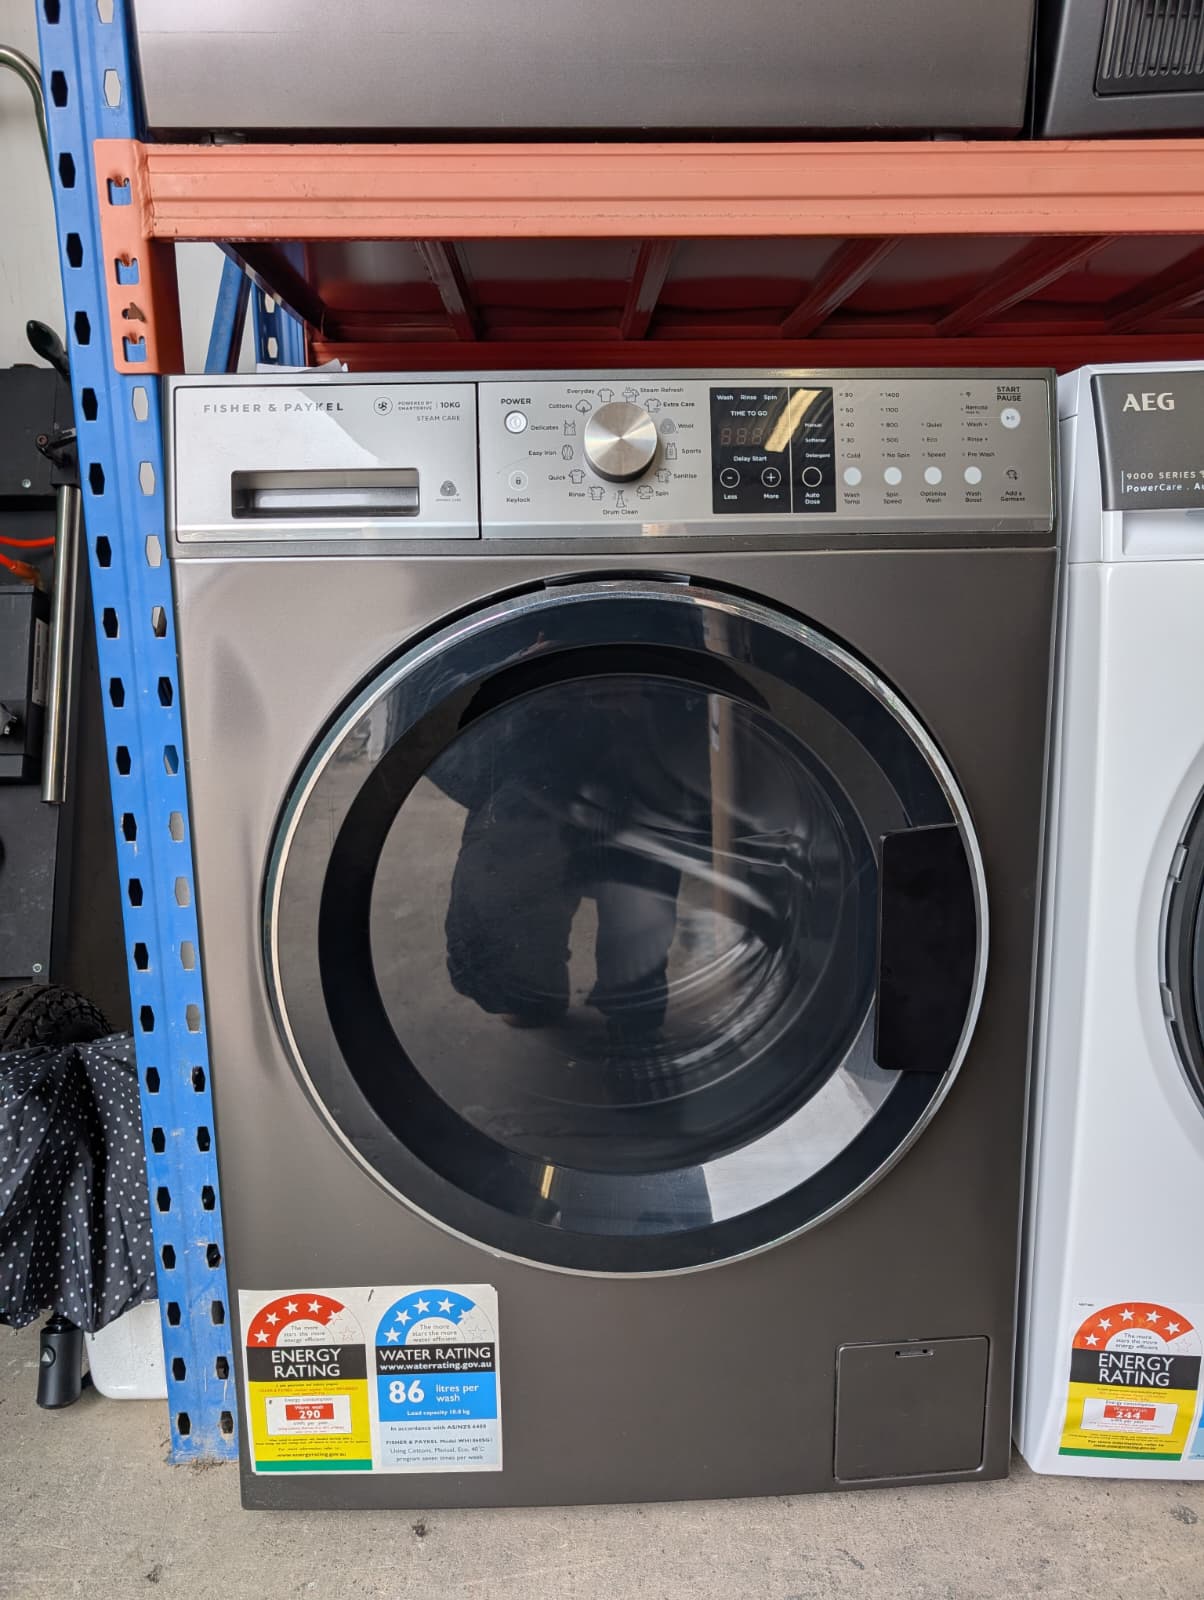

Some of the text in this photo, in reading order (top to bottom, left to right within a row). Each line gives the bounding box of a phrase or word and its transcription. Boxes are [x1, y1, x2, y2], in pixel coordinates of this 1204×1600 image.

[204, 402, 344, 413] FISHER & PAYKEL
[1122, 392, 1175, 412] AEG
[1158, 471, 1196, 479] SERIES
[1126, 483, 1182, 493] PowerCare
[271, 1348, 342, 1363] ENERGY
[379, 1347, 491, 1361] WATER RATING
[380, 1361, 492, 1371] www.waterrating.gov.au
[1098, 1353, 1174, 1371] ENERGY
[274, 1363, 340, 1378] RATING
[1098, 1369, 1170, 1386] RATING
[389, 1378, 479, 1404] 86 litres per
[436, 1394, 460, 1402] wash
[299, 1410, 321, 1419] 290
